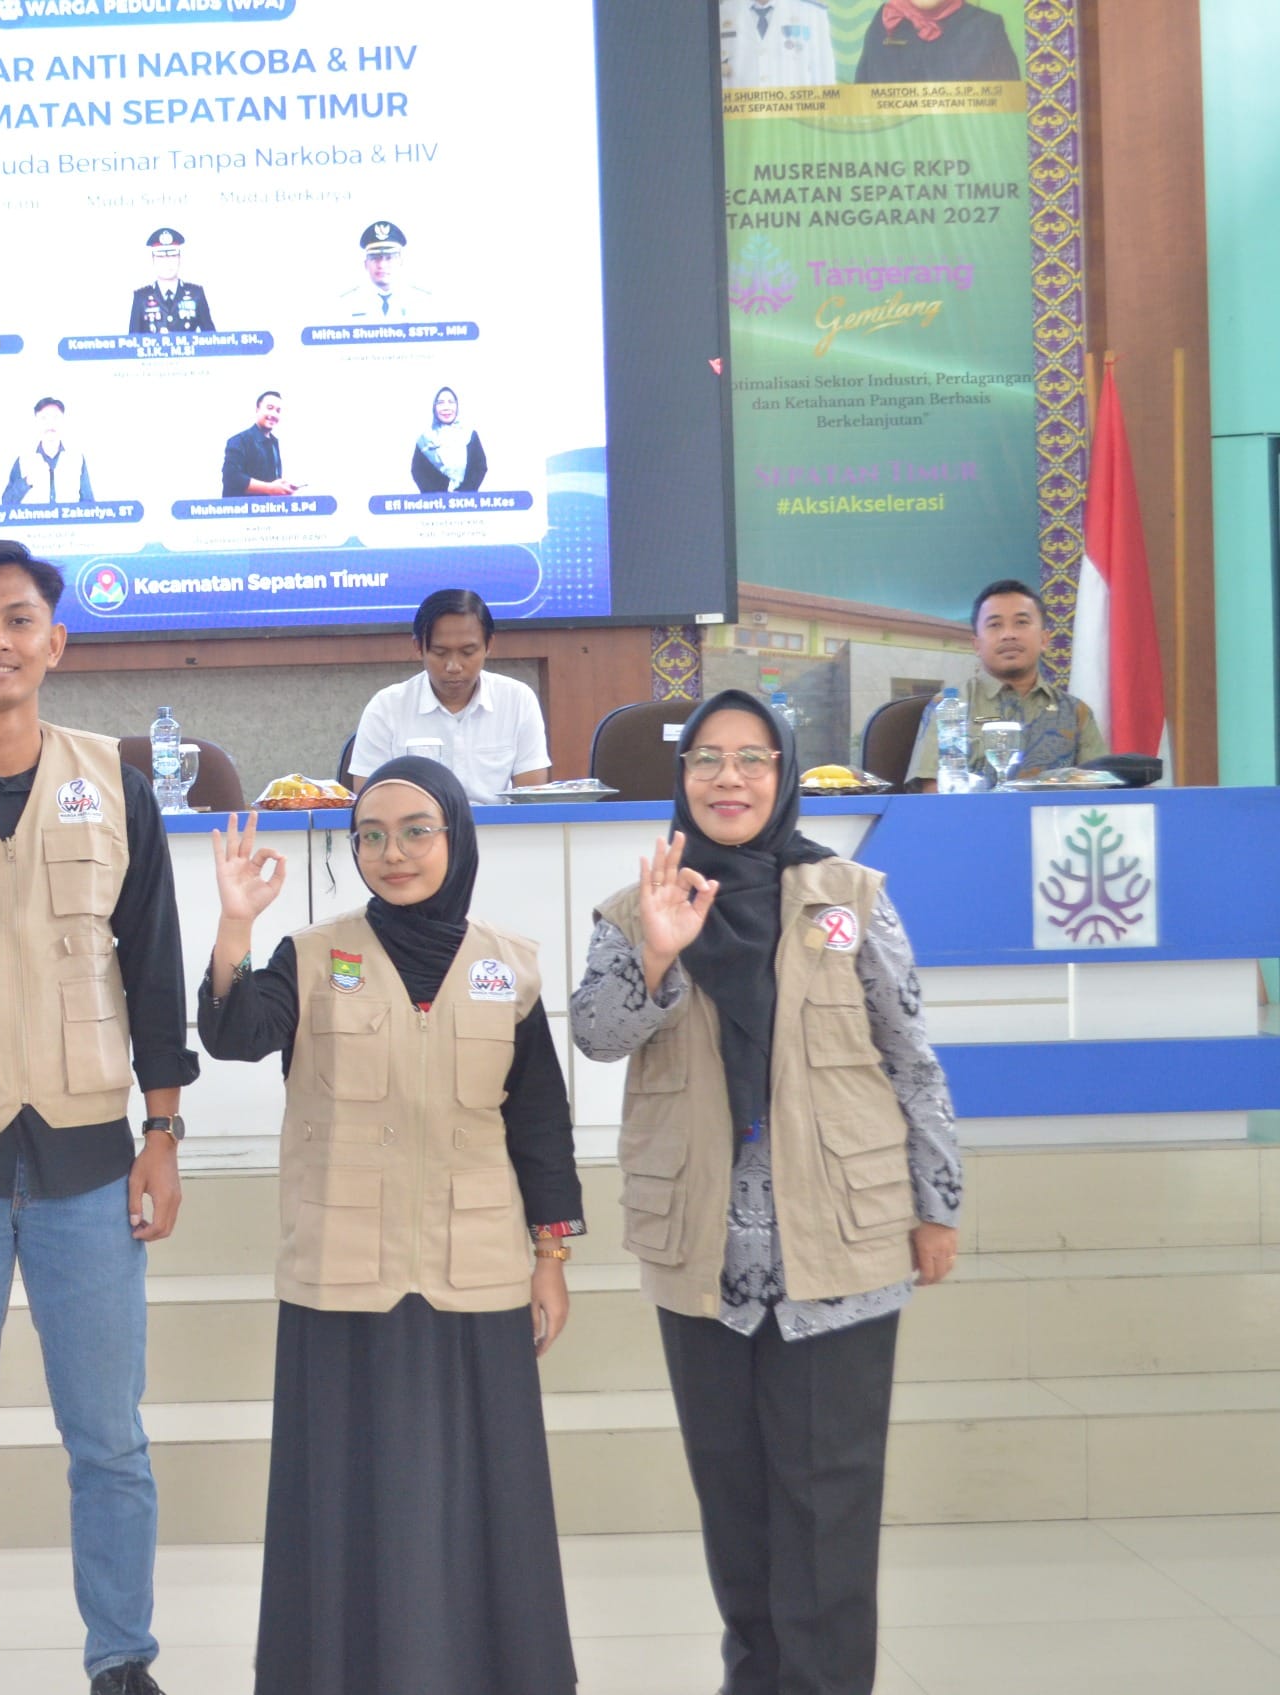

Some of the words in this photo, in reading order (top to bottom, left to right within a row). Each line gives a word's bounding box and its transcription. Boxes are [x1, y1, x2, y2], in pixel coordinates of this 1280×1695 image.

[27, 0, 100, 16] WARGA
[104, 0, 172, 15] PEDULI
[175, 0, 221, 12] AIDS
[45, 53, 127, 82] ANTI
[138, 48, 317, 78] NARKOBA
[327, 47, 348, 72] &
[358, 45, 418, 71] HIV
[822, 89, 840, 99] MM
[877, 100, 918, 109] SEKCAM
[921, 98, 965, 108] SEPATAN
[968, 98, 998, 107] TIMUR
[122, 96, 287, 125] SEPATAN
[297, 92, 409, 120] TIMUR
[724, 104, 745, 114] MAT
[748, 103, 793, 113] SEPATAN
[796, 102, 826, 111] TIMUR
[58, 151, 160, 174] Bersinar
[168, 149, 247, 174] Tanpa
[255, 144, 363, 168] Narkoba
[370, 143, 387, 164] &
[394, 142, 439, 163] HIV
[754, 161, 906, 182] MUSRENBANG
[914, 160, 970, 177] RKPD
[724, 187, 842, 206] ECAMATAN
[850, 184, 948, 202] SEPATAN
[956, 182, 1020, 200] TIMUR
[726, 211, 801, 230] TAHUN
[808, 208, 935, 228] ANGGARAN
[943, 206, 1000, 224] 2027
[807, 261, 974, 291] Tangerang
[312, 328, 350, 340] Miftah
[352, 326, 406, 340] Shuritho,
[446, 325, 467, 336] MM
[814, 291, 943, 358] Gemilang
[142, 337, 159, 347] Dr.
[161, 337, 173, 347] R.
[176, 336, 190, 346] M.
[192, 334, 238, 347] Jauhari,
[815, 374, 864, 389] Sektor
[936, 371, 1033, 388] Perdagangan
[751, 397, 780, 410] dan
[785, 395, 866, 410] Ketahanan
[869, 393, 925, 409] Pangan
[929, 391, 991, 406] Berbasis
[190, 503, 248, 516] Muhamad
[251, 501, 288, 514] Dzikri,
[291, 501, 317, 512] S.Pd
[776, 493, 945, 516] #AksiAkselerasi
[133, 575, 244, 596] Kecamatan
[247, 572, 327, 594] Sepatan
[330, 569, 389, 589] Timur
[65, 800, 97, 812] WPA
[475, 980, 511, 991] WPA
